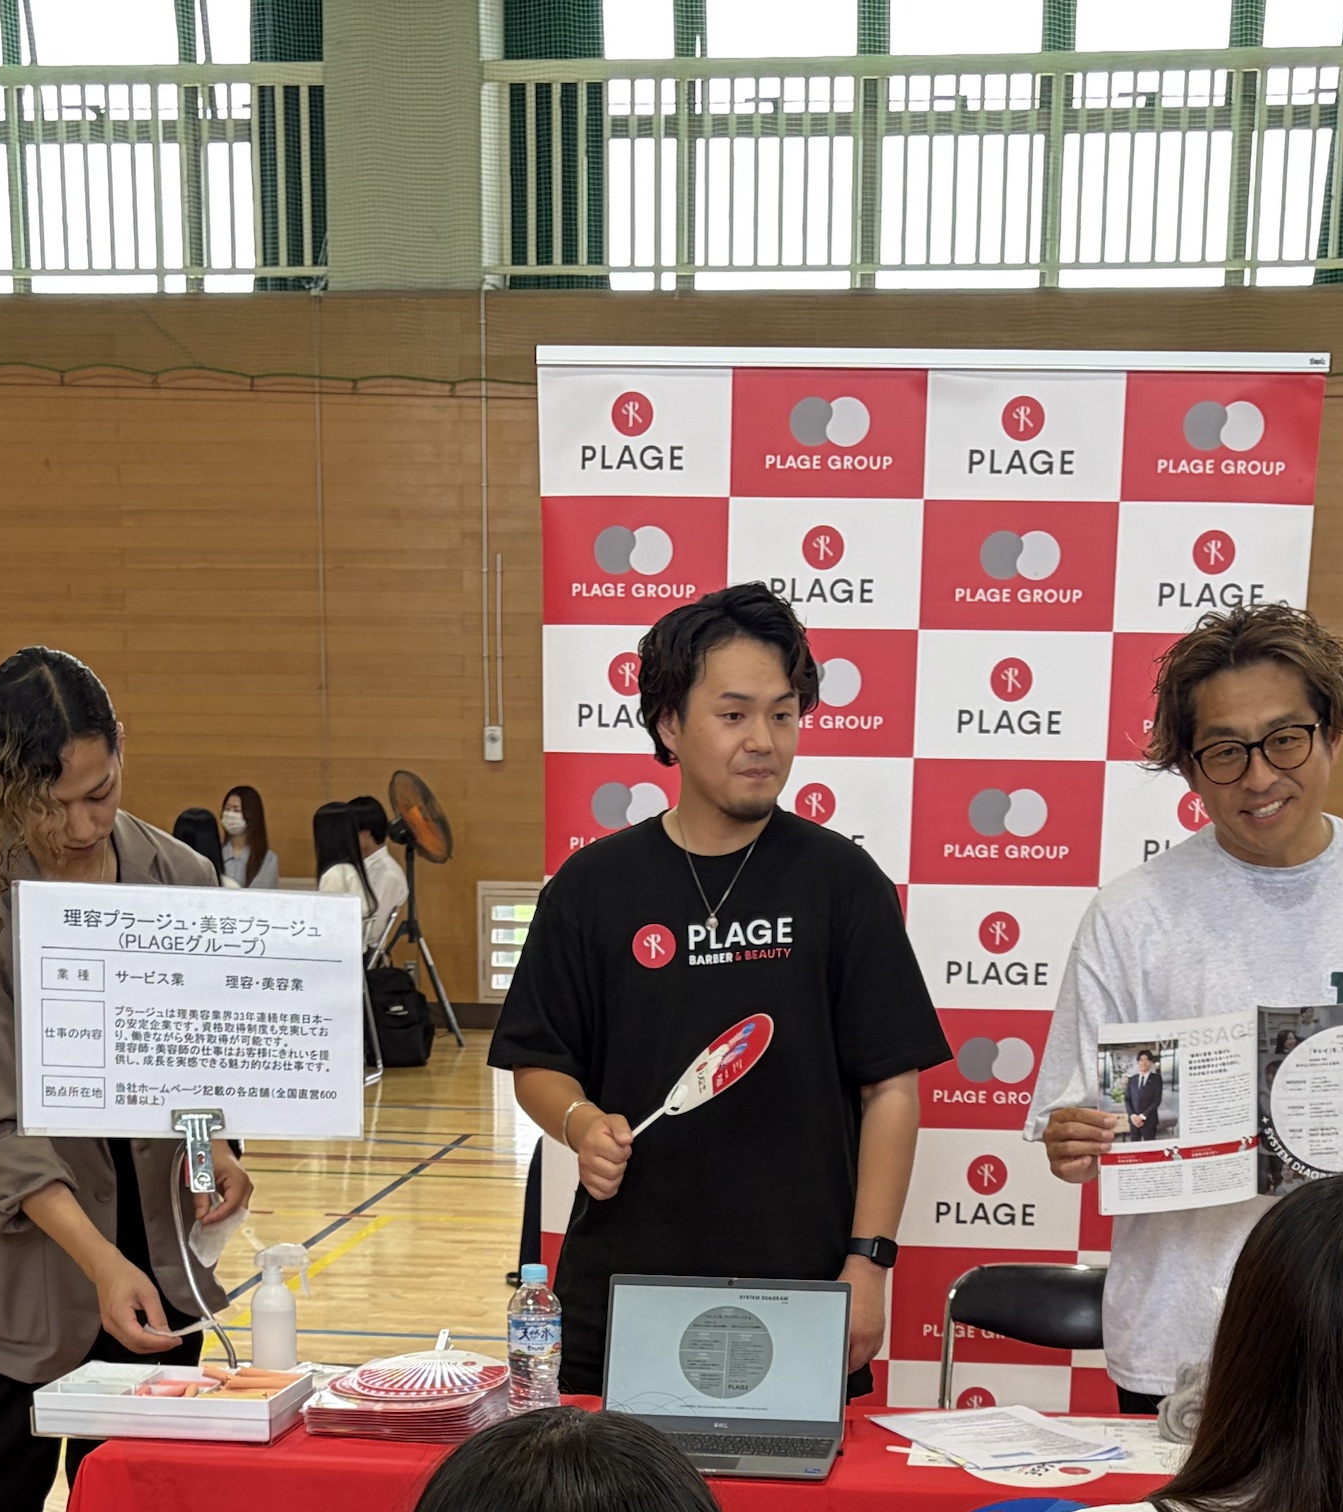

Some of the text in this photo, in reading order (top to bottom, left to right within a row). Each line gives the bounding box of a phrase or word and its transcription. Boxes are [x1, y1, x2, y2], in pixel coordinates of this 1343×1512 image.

[580, 444, 685, 472] PLAGE
[764, 453, 894, 472] PLAGE GROUP
[968, 449, 1076, 476] PLAGE
[1157, 458, 1286, 476] PLAGE GROUP
[571, 582, 697, 600] PLAGE GROUP
[770, 577, 875, 604] PLAGE
[954, 587, 1084, 605] PLAGE GROUP
[1157, 581, 1265, 609] PLAGE
[577, 702, 648, 729] PLA
[819, 714, 885, 731] GROUP
[956, 708, 1062, 736] PLAGE
[943, 843, 1070, 861] PLAGE GROUP
[62, 908, 323, 938] 理容プラージュ・美容プラージュ
[687, 917, 794, 950] PLAGE
[688, 951, 734, 967] BARBER
[744, 948, 793, 962] BEAUTY
[115, 970, 185, 987] サービス業
[225, 974, 305, 992] 理容・美容業
[945, 960, 1050, 987] PLAGE
[44, 1026, 103, 1041] 仕事の内容
[1156, 1020, 1256, 1050] MESSAGE
[44, 1085, 104, 1100] 拠点所在地
[932, 1089, 1032, 1106] PLAGE GRO
[1264, 1127, 1335, 1180] SYSTEM DIAGR
[934, 1201, 1037, 1227] PLAGE
[518, 1326, 554, 1341] 天然水
[922, 1323, 975, 1339] PLGE
